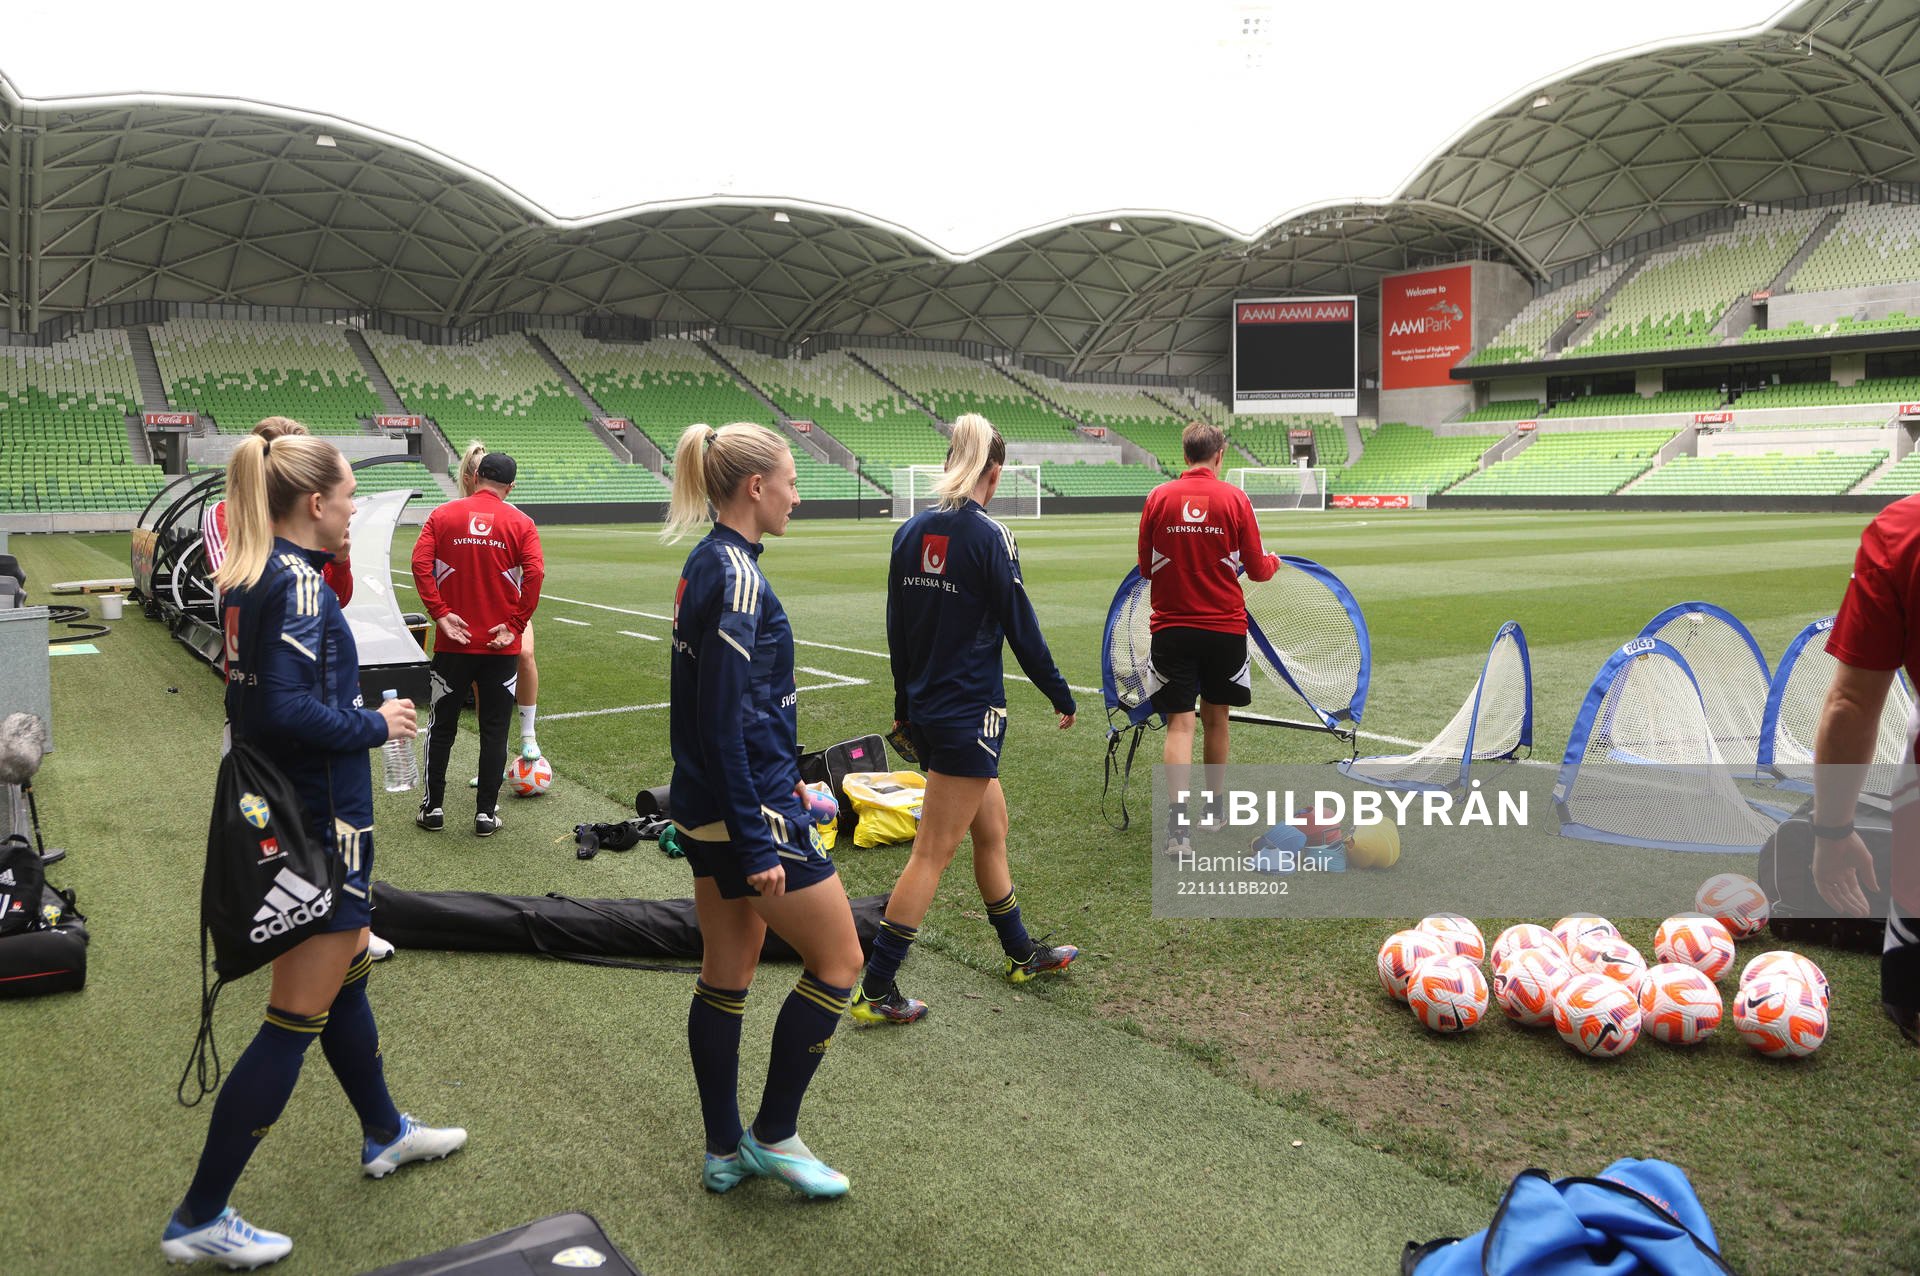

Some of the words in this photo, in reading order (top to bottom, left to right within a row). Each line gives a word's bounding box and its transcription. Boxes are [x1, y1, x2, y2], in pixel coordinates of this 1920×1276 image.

[1406, 286, 1437, 297] Welcome
[1242, 308, 1275, 320] AAMI
[1279, 307, 1312, 319] AAMI
[1315, 306, 1348, 318] AAMI
[1166, 525, 1203, 534] SVENSKA
[1204, 526, 1225, 535] SPEL
[453, 537, 487, 546] SVENSKA
[488, 539, 507, 550] SPEL
[903, 576, 940, 588] SVENSKA
[249, 887, 334, 944] adidas
